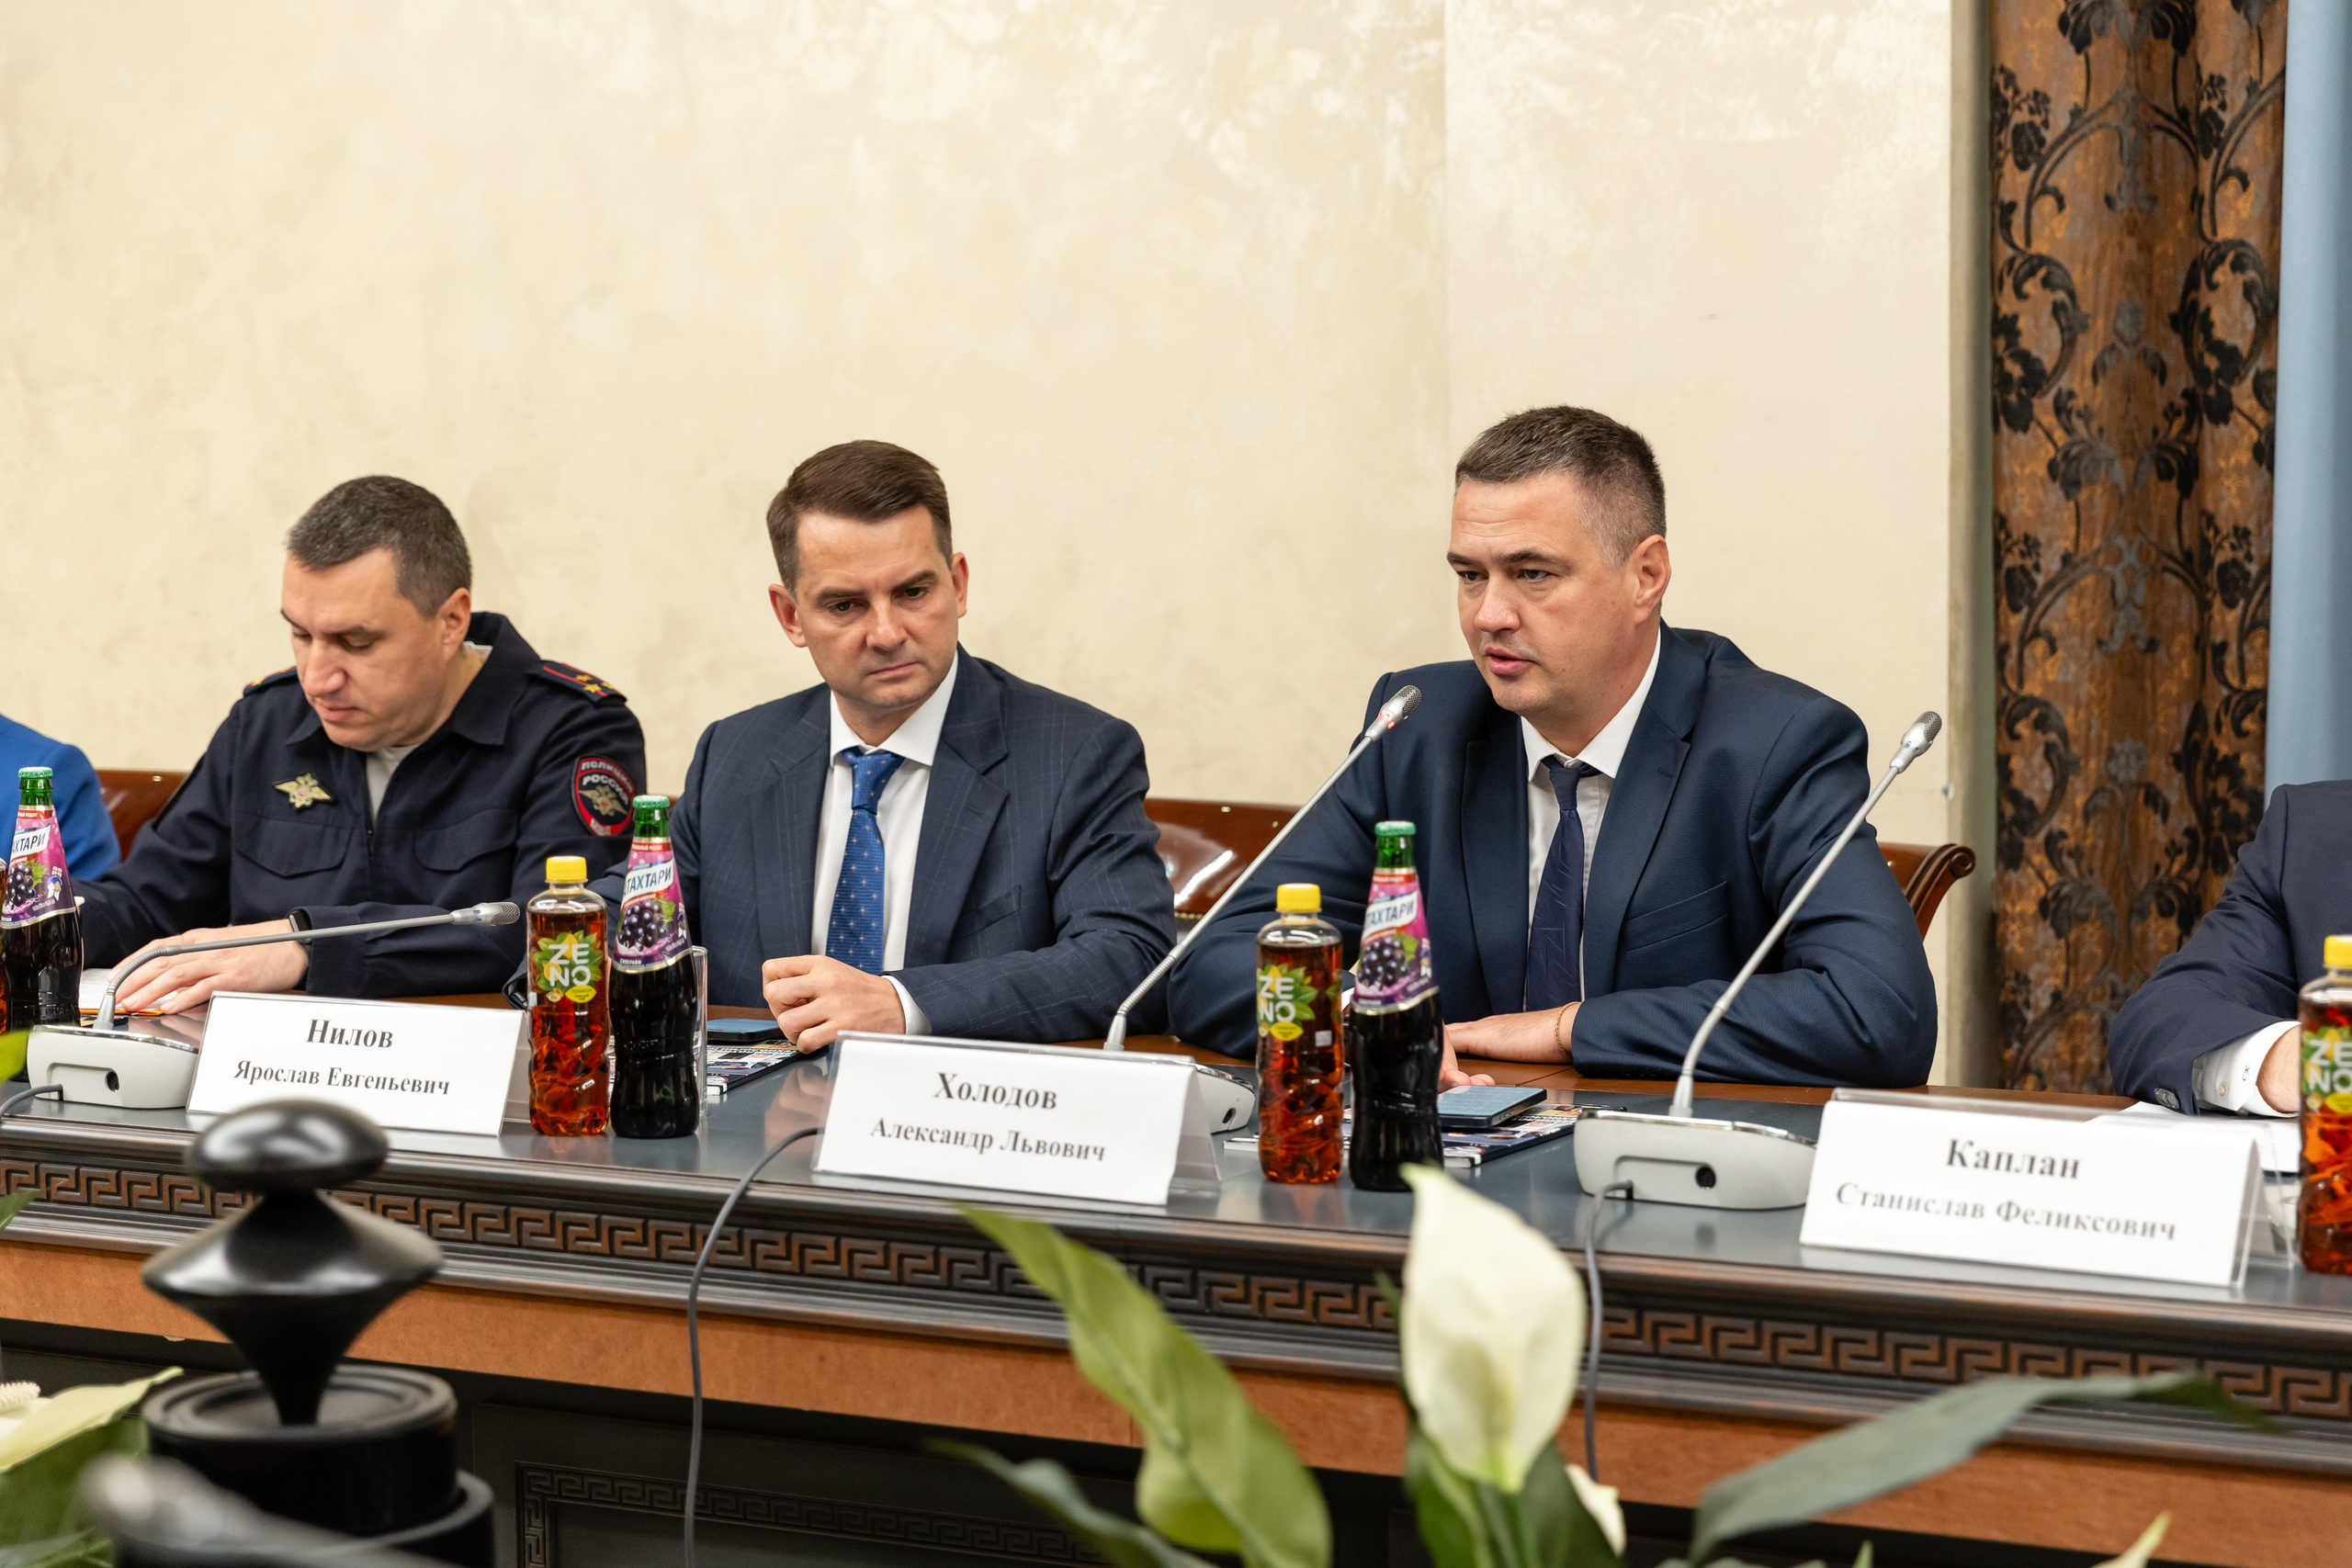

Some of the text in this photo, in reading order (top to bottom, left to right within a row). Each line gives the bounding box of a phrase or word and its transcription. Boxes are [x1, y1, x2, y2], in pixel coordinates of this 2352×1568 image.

[306, 1019, 393, 1048] Нилов
[233, 1060, 450, 1095] Ярослав Евгеньевич
[933, 1072, 1057, 1109] Холодов
[870, 1118, 1106, 1161] Александр Львович
[1945, 1138, 2081, 1179] Каплан
[1836, 1180, 2177, 1241] Станислав Феликсович
